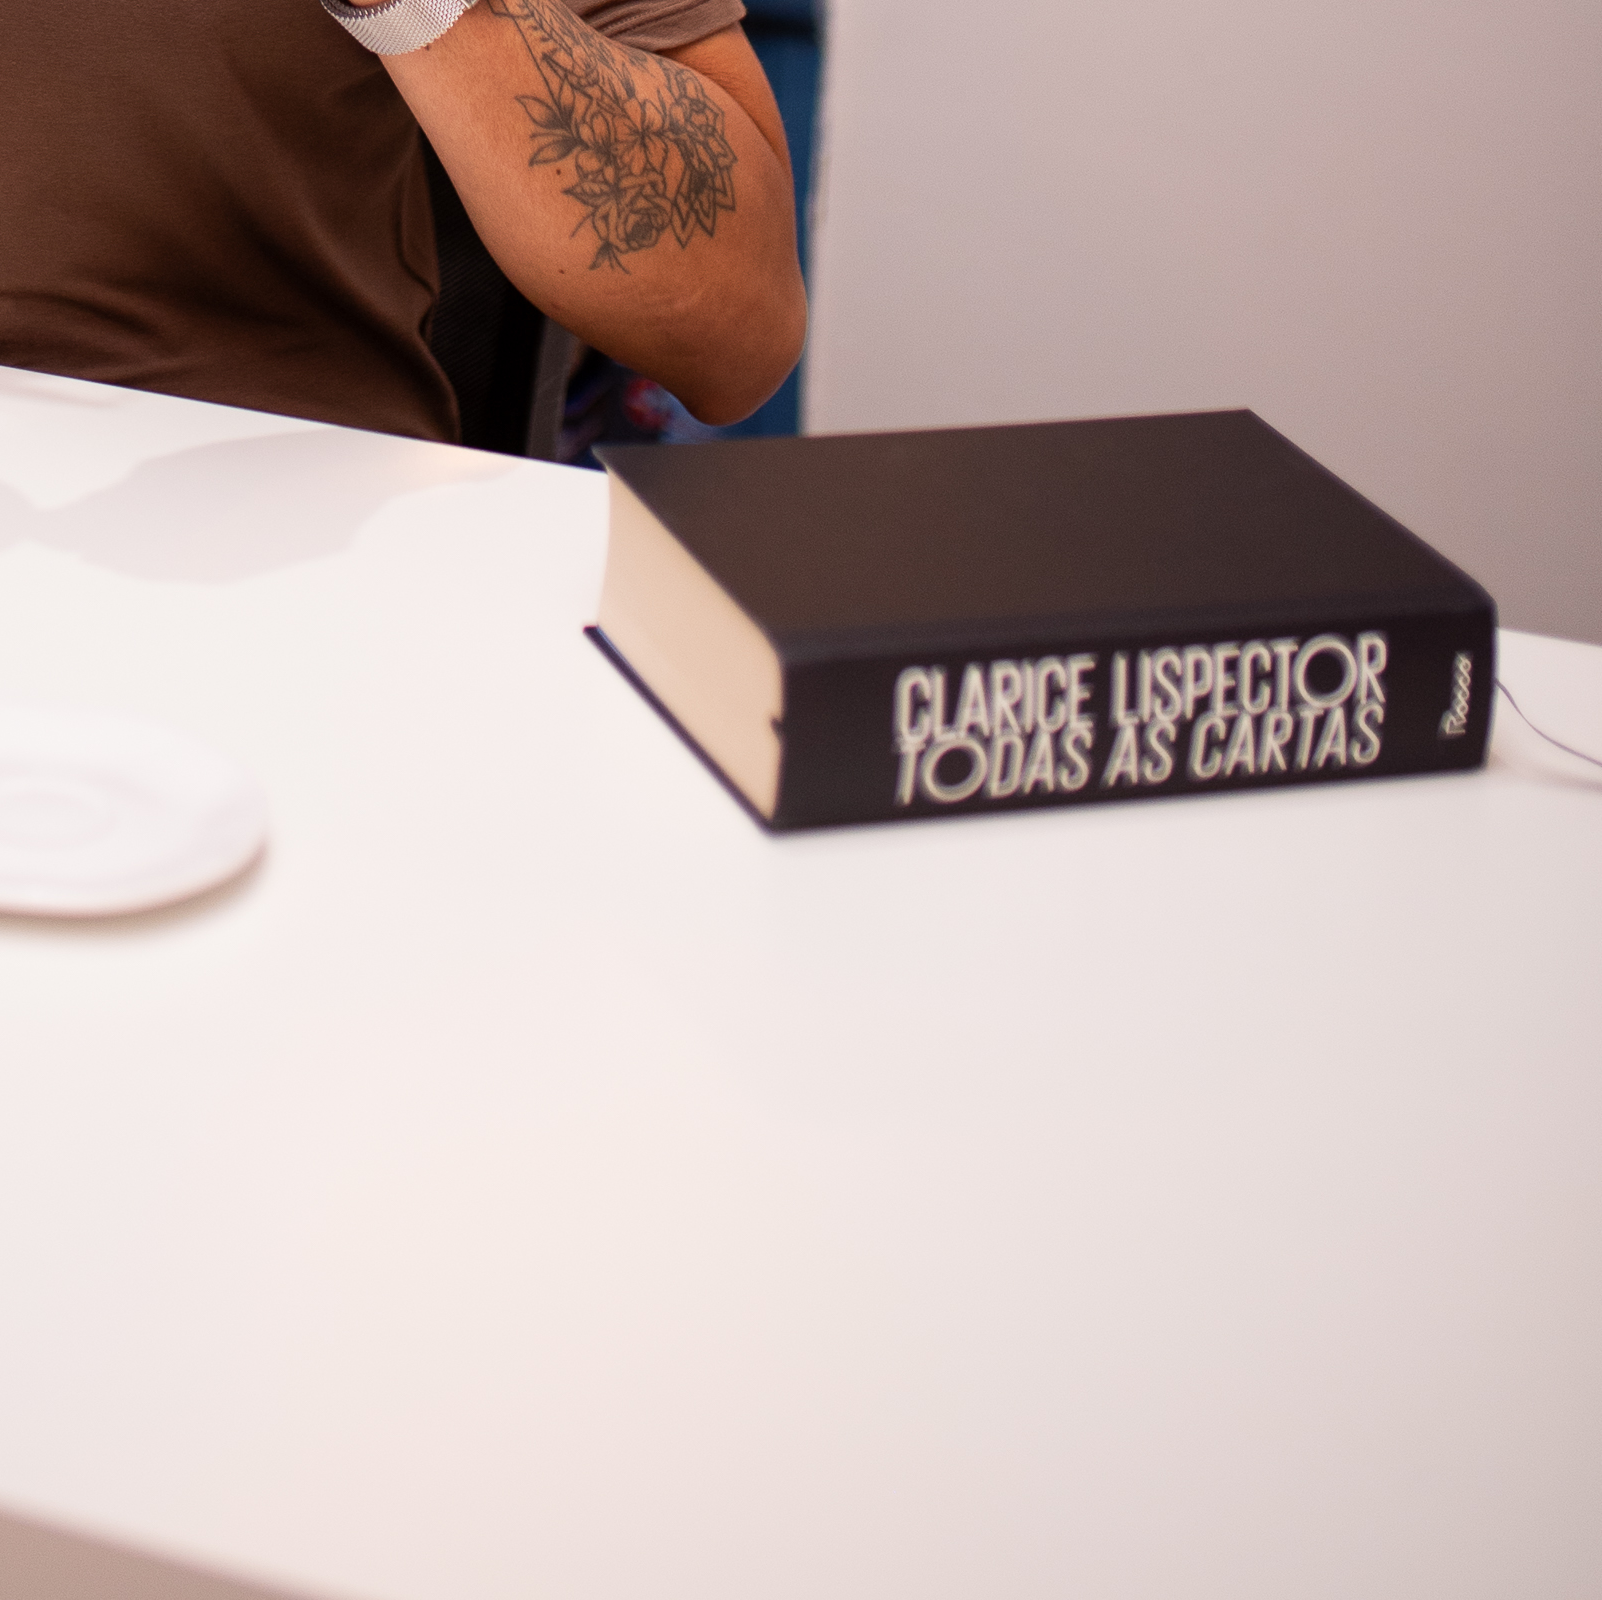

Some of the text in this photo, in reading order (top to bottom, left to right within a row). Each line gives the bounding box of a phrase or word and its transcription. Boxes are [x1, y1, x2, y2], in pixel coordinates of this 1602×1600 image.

[896, 632, 1388, 744] CLARICE LISPECTOR
[1439, 651, 1473, 738] Rocco
[897, 702, 1386, 806] TODAS AS CARTAS
